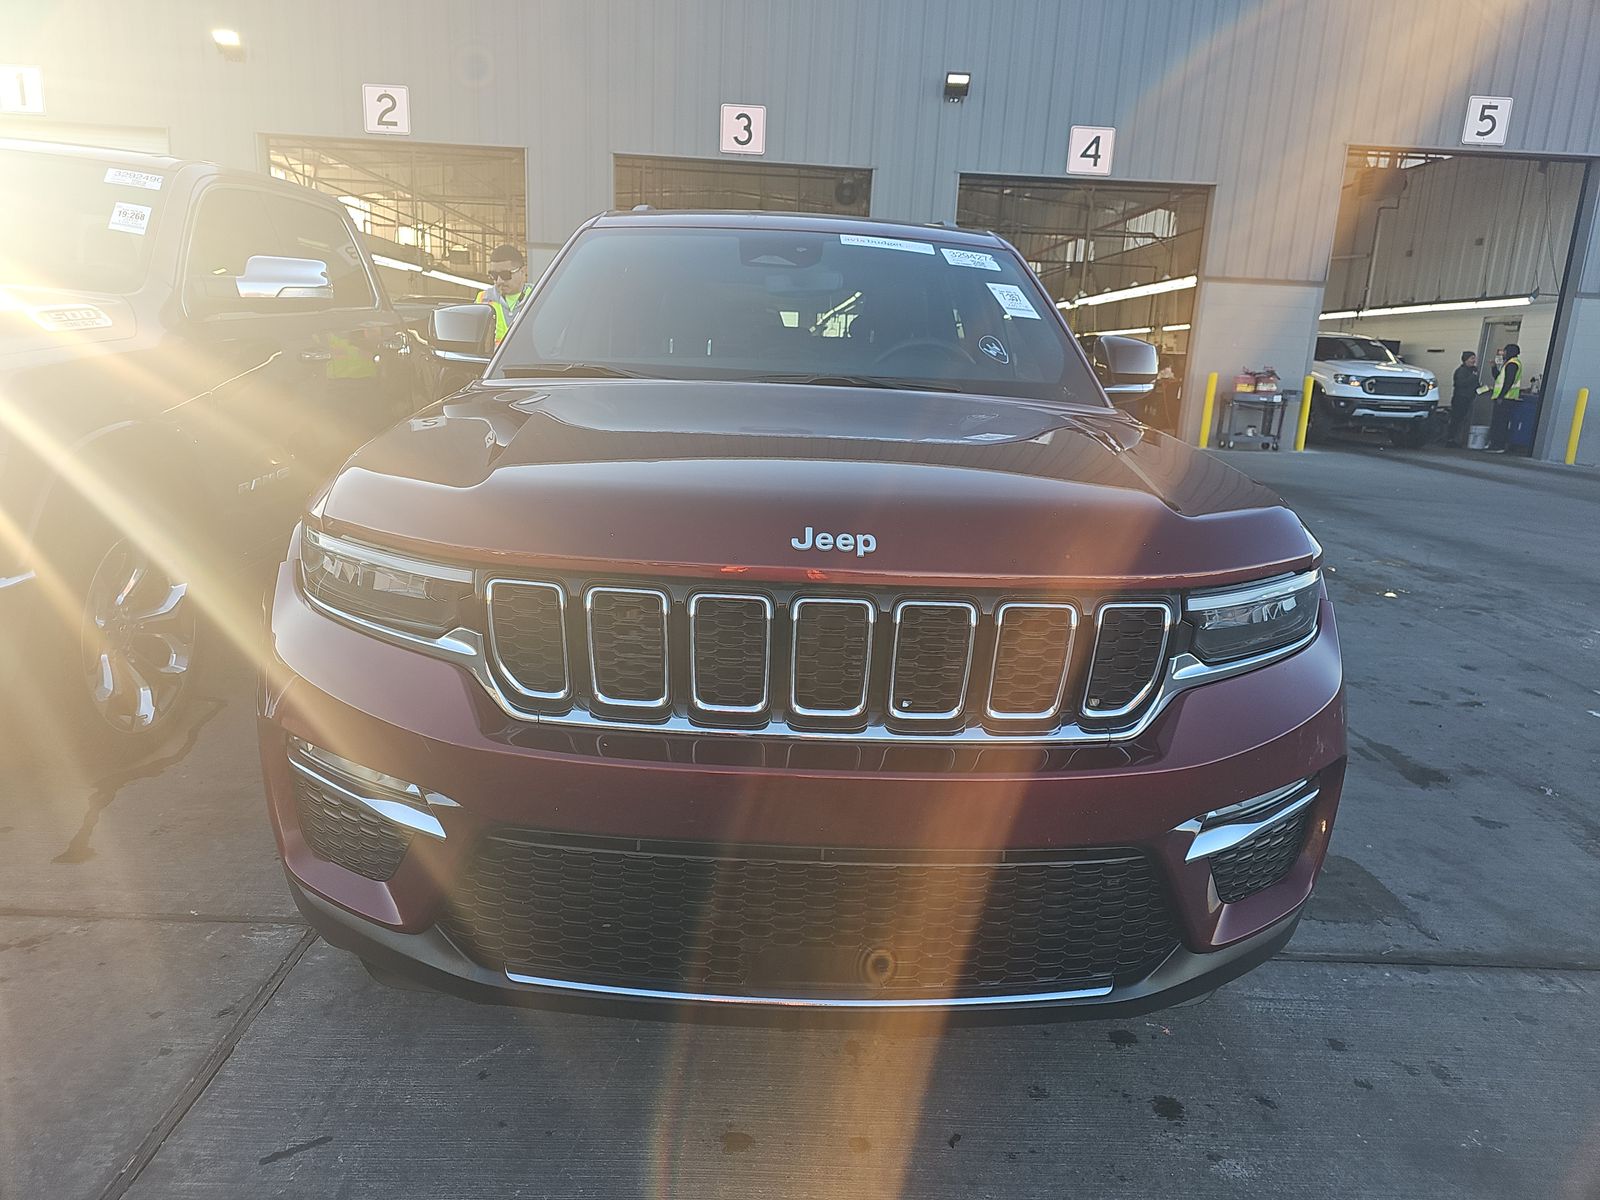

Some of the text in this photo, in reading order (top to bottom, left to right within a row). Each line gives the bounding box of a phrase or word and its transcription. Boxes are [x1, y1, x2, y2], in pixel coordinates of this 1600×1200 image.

[16, 73, 27, 106] 1
[377, 93, 398, 127] 2
[1475, 104, 1499, 137] 5
[733, 112, 753, 146] 3
[1080, 135, 1102, 167] 4
[790, 527, 877, 558] Jeep
